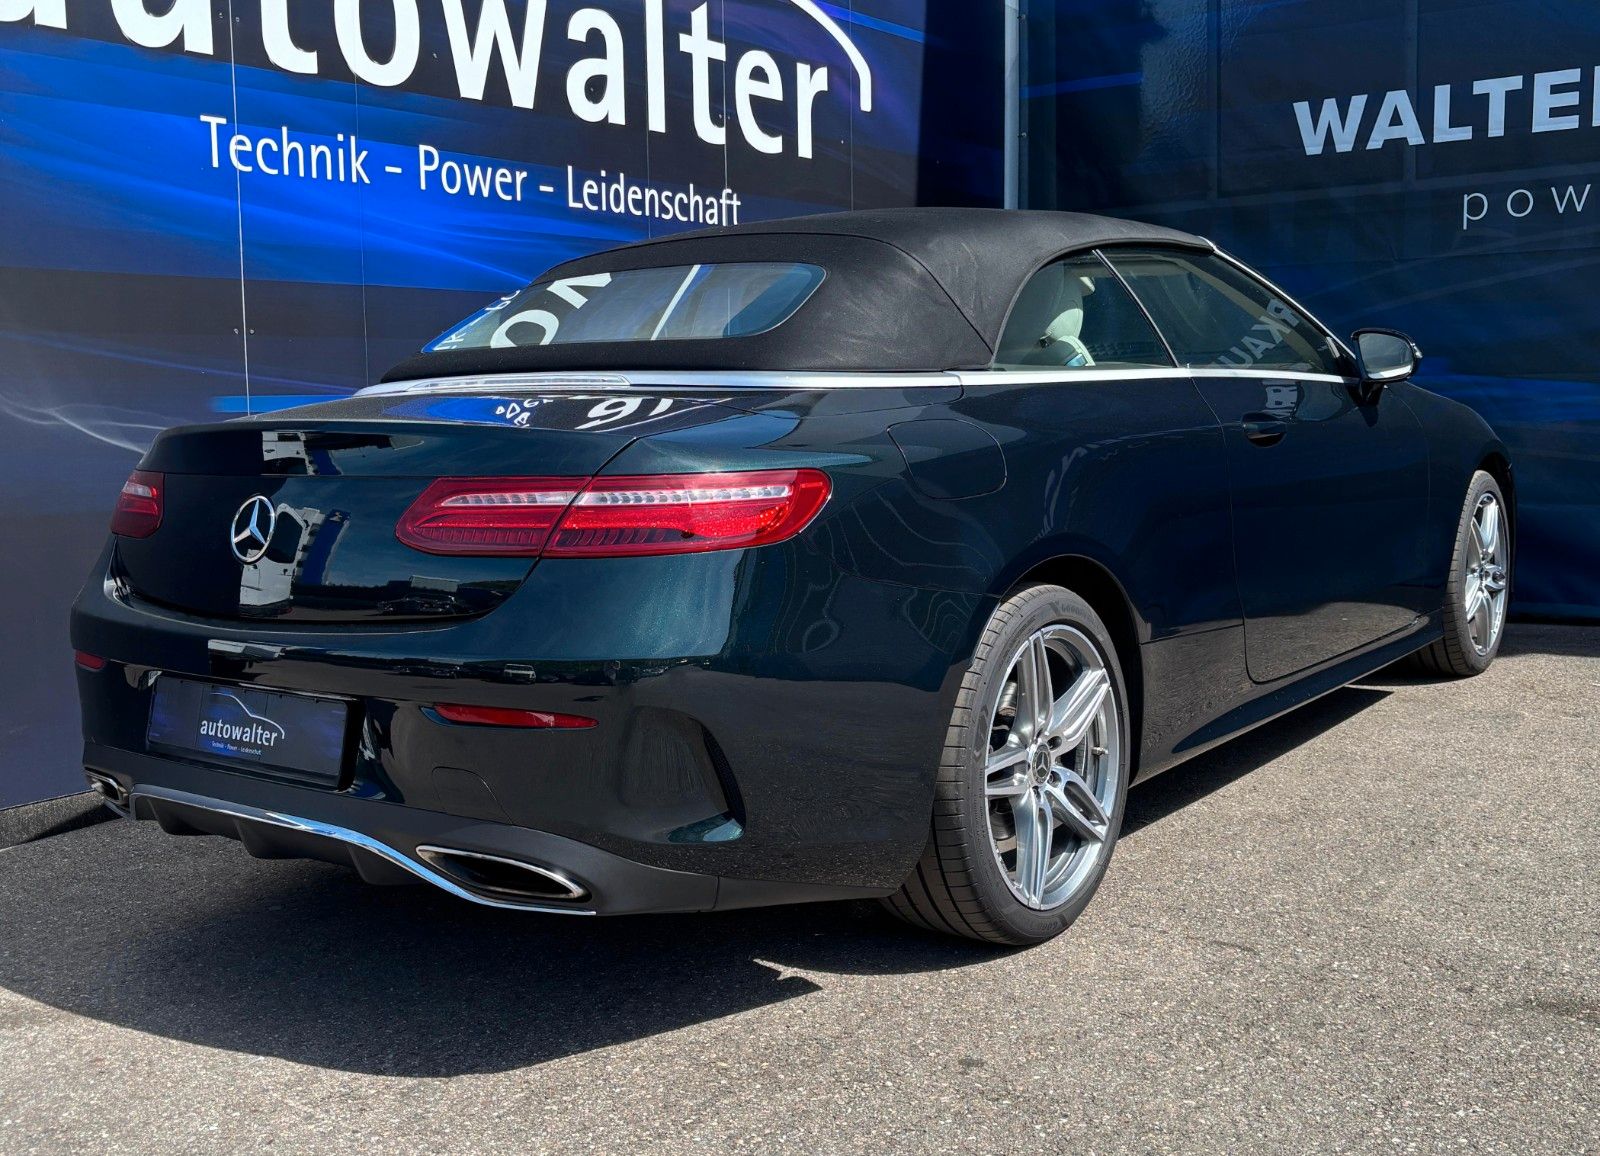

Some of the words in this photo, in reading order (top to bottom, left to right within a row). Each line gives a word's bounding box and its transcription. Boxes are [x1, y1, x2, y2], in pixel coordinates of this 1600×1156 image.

[1293, 65, 1600, 156] WALTE
[200, 114, 371, 184] Technik
[418, 144, 528, 202] Power
[566, 164, 742, 227] Leidenschaft
[199, 719, 278, 747] autowalter
